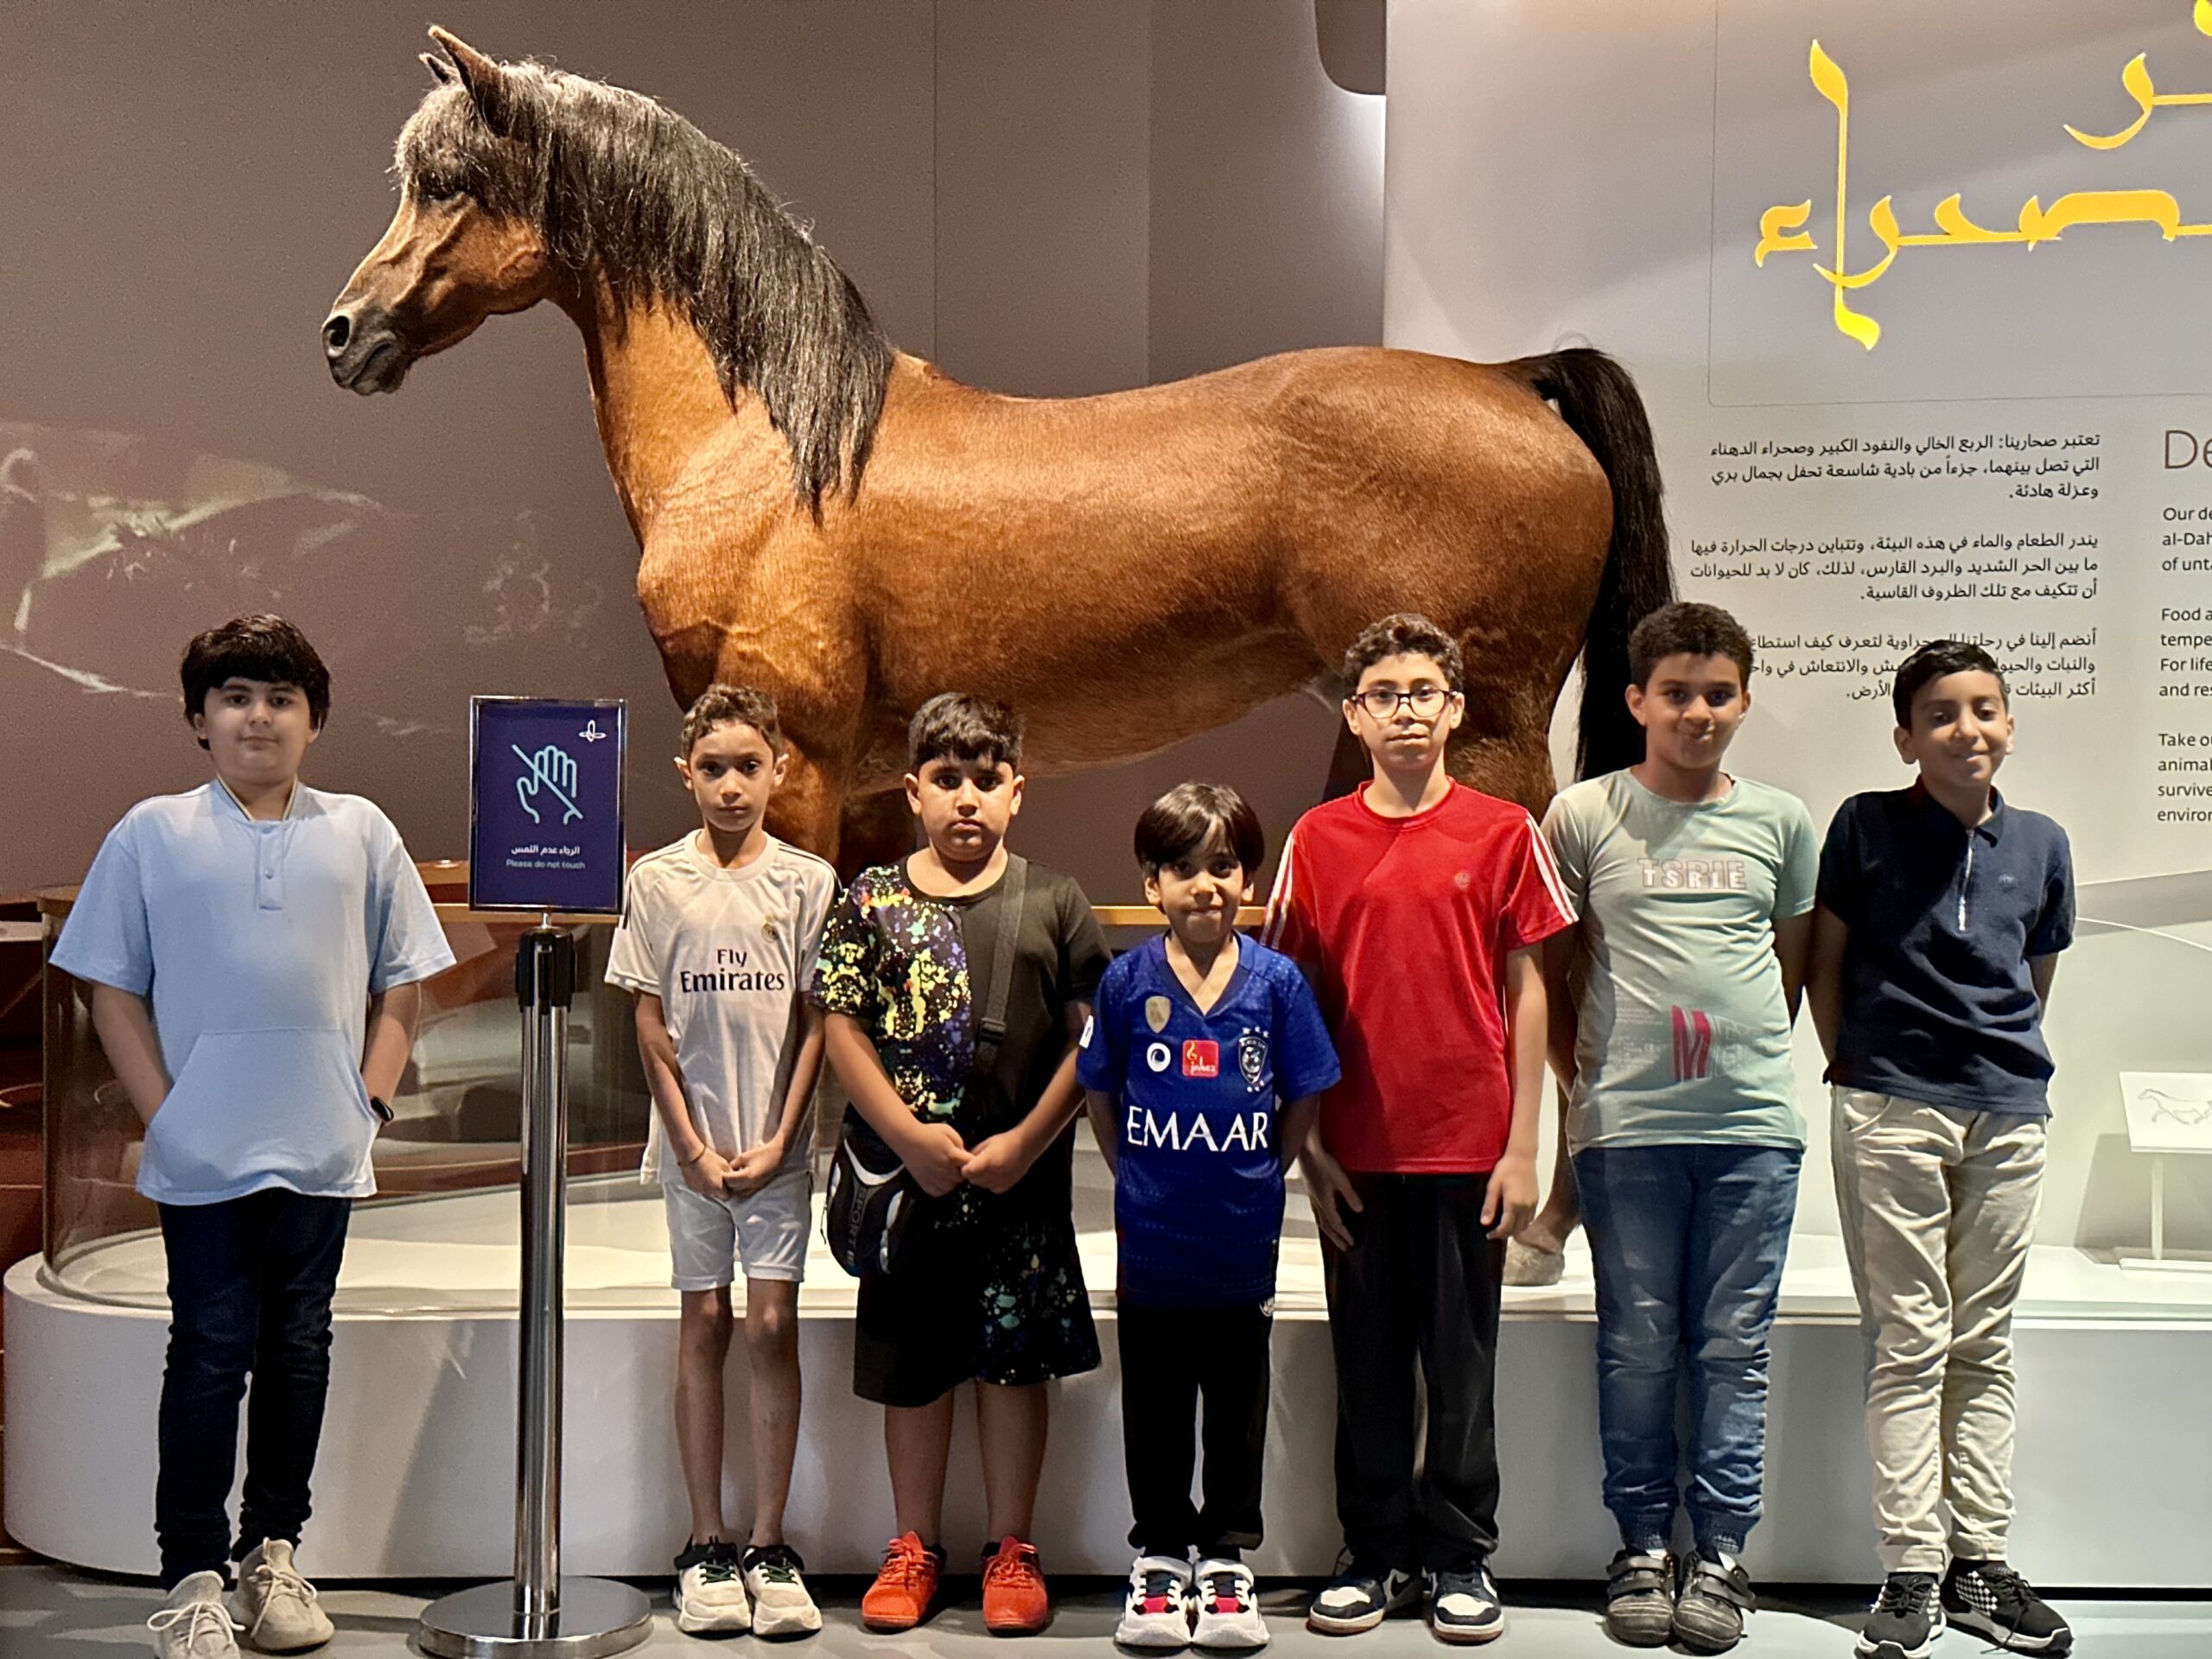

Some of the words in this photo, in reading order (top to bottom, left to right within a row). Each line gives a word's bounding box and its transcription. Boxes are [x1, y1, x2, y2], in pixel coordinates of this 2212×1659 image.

[1711, 442, 1757, 457] الدهناء
[1761, 441, 1815, 457] وصحراء
[1819, 438, 1858, 456] الكبير
[1862, 437, 1911, 454] والنفود
[1916, 435, 1955, 456] الخالي
[1958, 435, 1993, 454] الربع
[1999, 434, 2057, 452] صحارينا:
[2061, 435, 2100, 452] تعتبر
[1742, 466, 1783, 483] بجمال
[1787, 464, 1822, 481] تحفل
[1826, 462, 1879, 478] شاسعة
[1884, 461, 1915, 479] بادية
[1920, 467, 1942, 479] من
[1982, 459, 2031, 477] بينهما،
[2035, 457, 2069, 475] تصل
[2073, 456, 2100, 477] التي
[1712, 471, 1738, 486] بري
[2009, 483, 2054, 499] هادئة.
[2057, 482, 2098, 499] وعزلة
[2163, 507, 2195, 521] Our
[1692, 540, 1717, 556] فيها
[1721, 538, 1766, 556] الحرارة
[1770, 538, 1814, 556] درجات
[1818, 537, 1864, 555] وتتباين
[1916, 537, 1945, 550] هذه
[1948, 537, 1967, 554] في
[1973, 534, 2012, 550] والماء
[2017, 532, 2063, 550] الطعام
[2069, 535, 2098, 550] يندر
[1691, 563, 1751, 580] للحيوانات
[1775, 562, 1784, 575] لا
[1789, 562, 1810, 580] كان
[1816, 561, 1855, 576] لذلك،
[1920, 559, 1962, 577] والبرد
[1967, 558, 2018, 575] الشديد
[2021, 557, 2050, 575] الحر
[2055, 563, 2079, 575] بين
[2084, 556, 2098, 571] ما
[2161, 556, 2179, 571] of
[1756, 567, 1770, 579] بد
[1860, 584, 1917, 601] القاسية.
[1922, 583, 1976, 602] الظروف
[1980, 582, 2007, 598] تلك
[2011, 587, 2031, 601] مع
[2035, 582, 2078, 599] تتكيف
[2082, 577, 2097, 599] أن
[2162, 607, 2201, 622] Food
[1804, 634, 1834, 652] كيف
[1839, 633, 1882, 652] لتعرف
[2005, 633, 2025, 652] في
[2031, 632, 2056, 651] إلينا
[2059, 627, 2097, 650] أنضم
[1777, 660, 1795, 678] في
[1799, 658, 1869, 677] والانتعاش
[1995, 657, 2043, 675] والحيوا
[2047, 656, 2096, 674] والنبات
[2161, 658, 2188, 672] For
[2190, 657, 2212, 672] life
[2016, 682, 2063, 698] البيئات
[2066, 677, 2095, 699] أكثر
[2159, 682, 2190, 696] and
[2158, 733, 2196, 747] Take
[2158, 778, 2212, 798] survive
[511, 844, 538, 855] اللمس
[540, 847, 558, 856] عدم
[559, 845, 580, 856] الرجاء
[505, 859, 533, 868] Please
[534, 860, 545, 868] do
[562, 861, 586, 869] touch
[717, 949, 747, 968] Fly
[680, 968, 785, 993] Emirates
[1127, 1105, 1268, 1152] EMAAR
